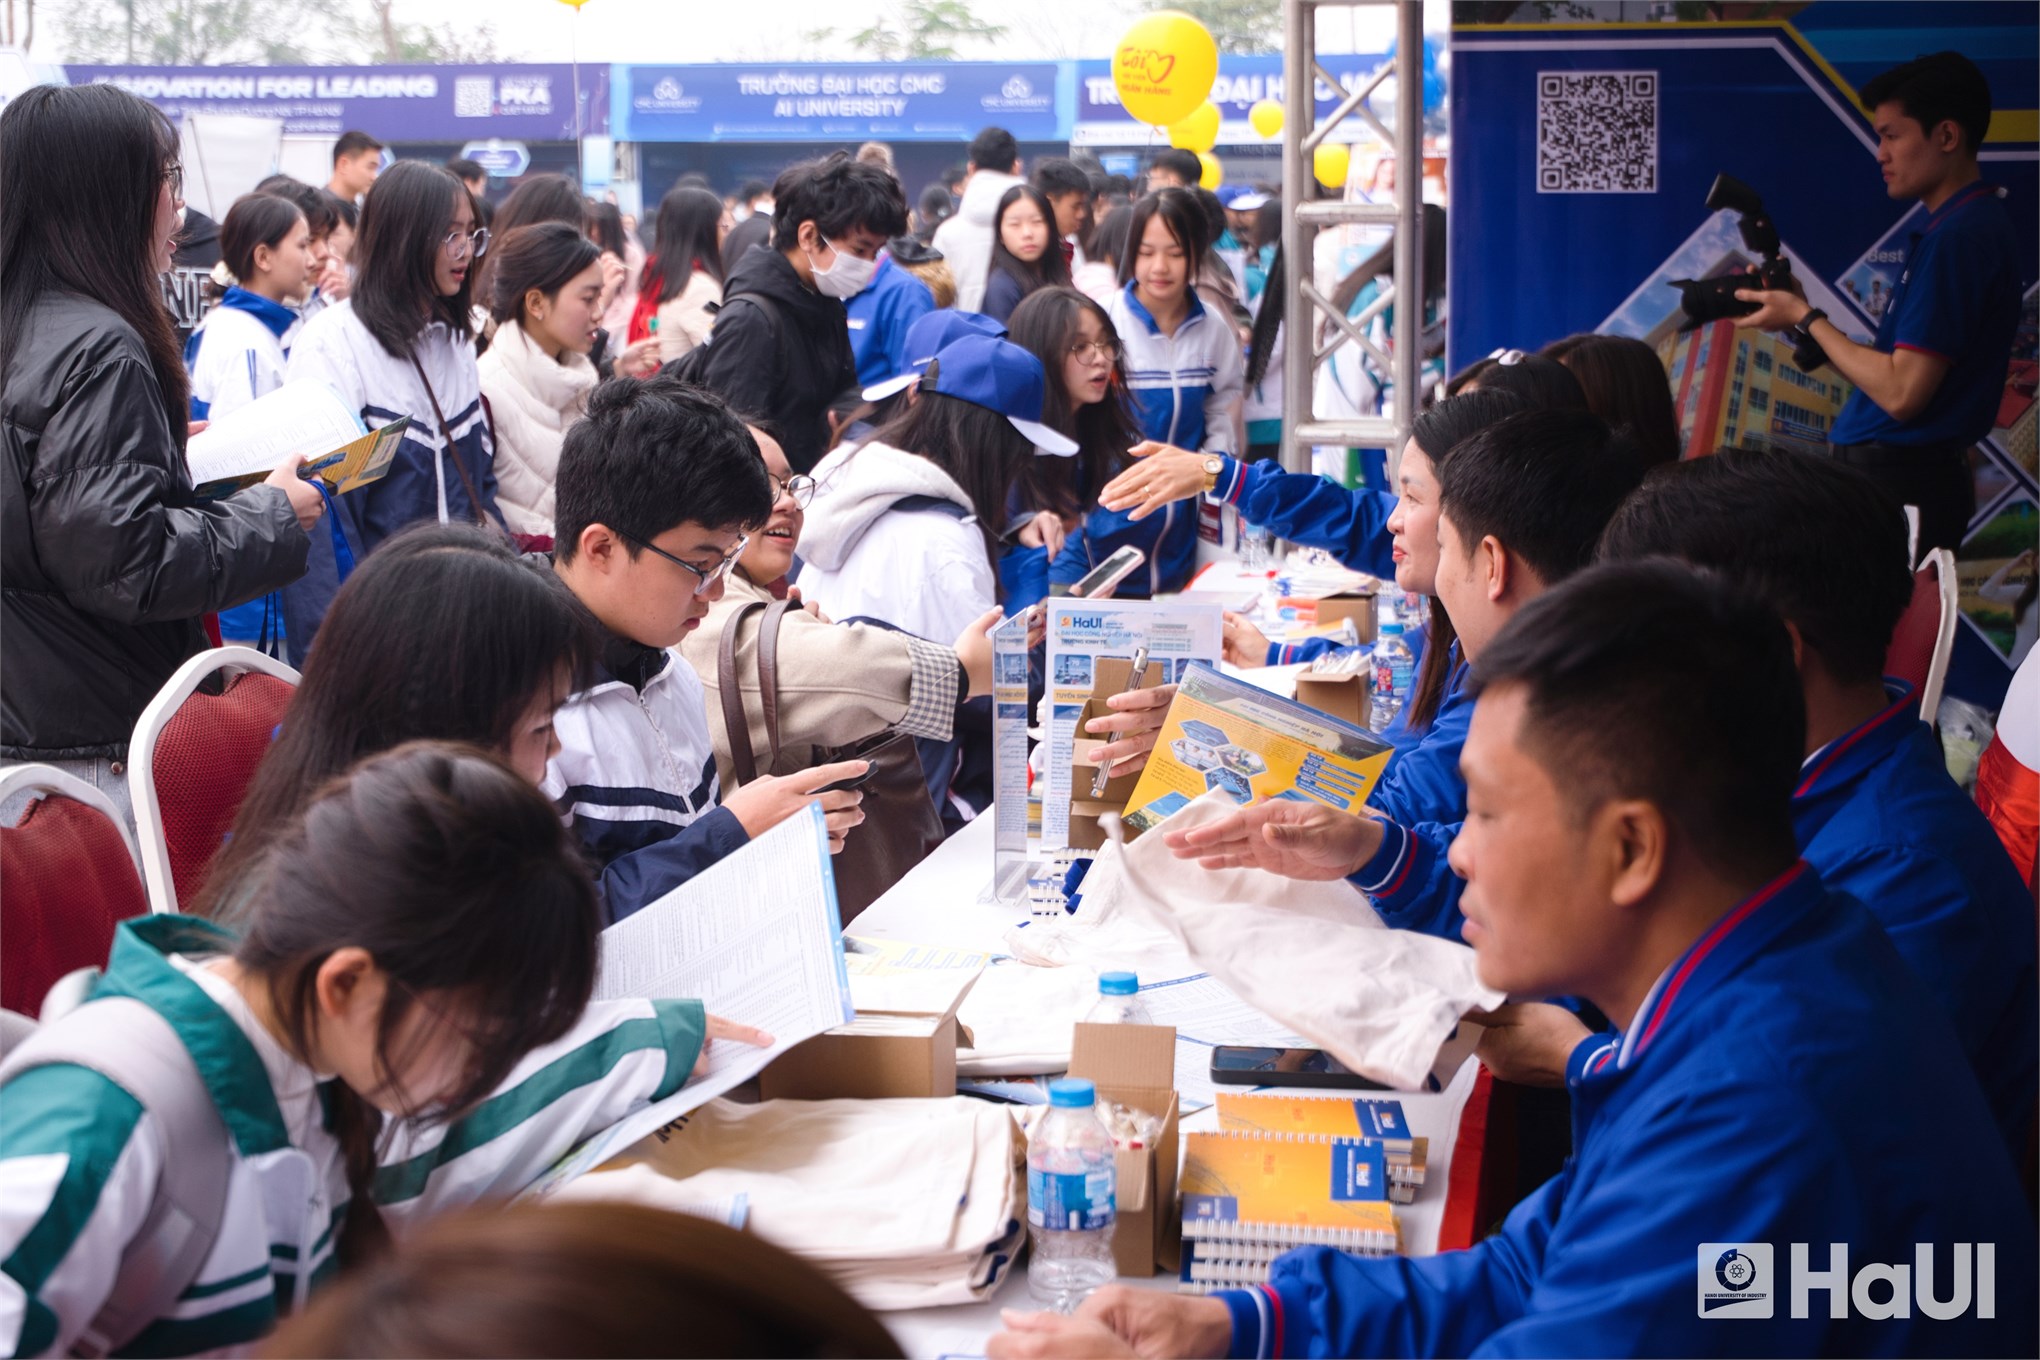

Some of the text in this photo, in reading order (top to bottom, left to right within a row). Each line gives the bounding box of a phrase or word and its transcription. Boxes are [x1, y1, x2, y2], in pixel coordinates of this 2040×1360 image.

[256, 75, 314, 98] FOR
[316, 74, 438, 98] LEADING
[856, 74, 899, 97] HỌC
[773, 97, 909, 117] AI UNIVERSITY
[1867, 249, 1905, 263] Best
[1073, 617, 1102, 628] HaUI
